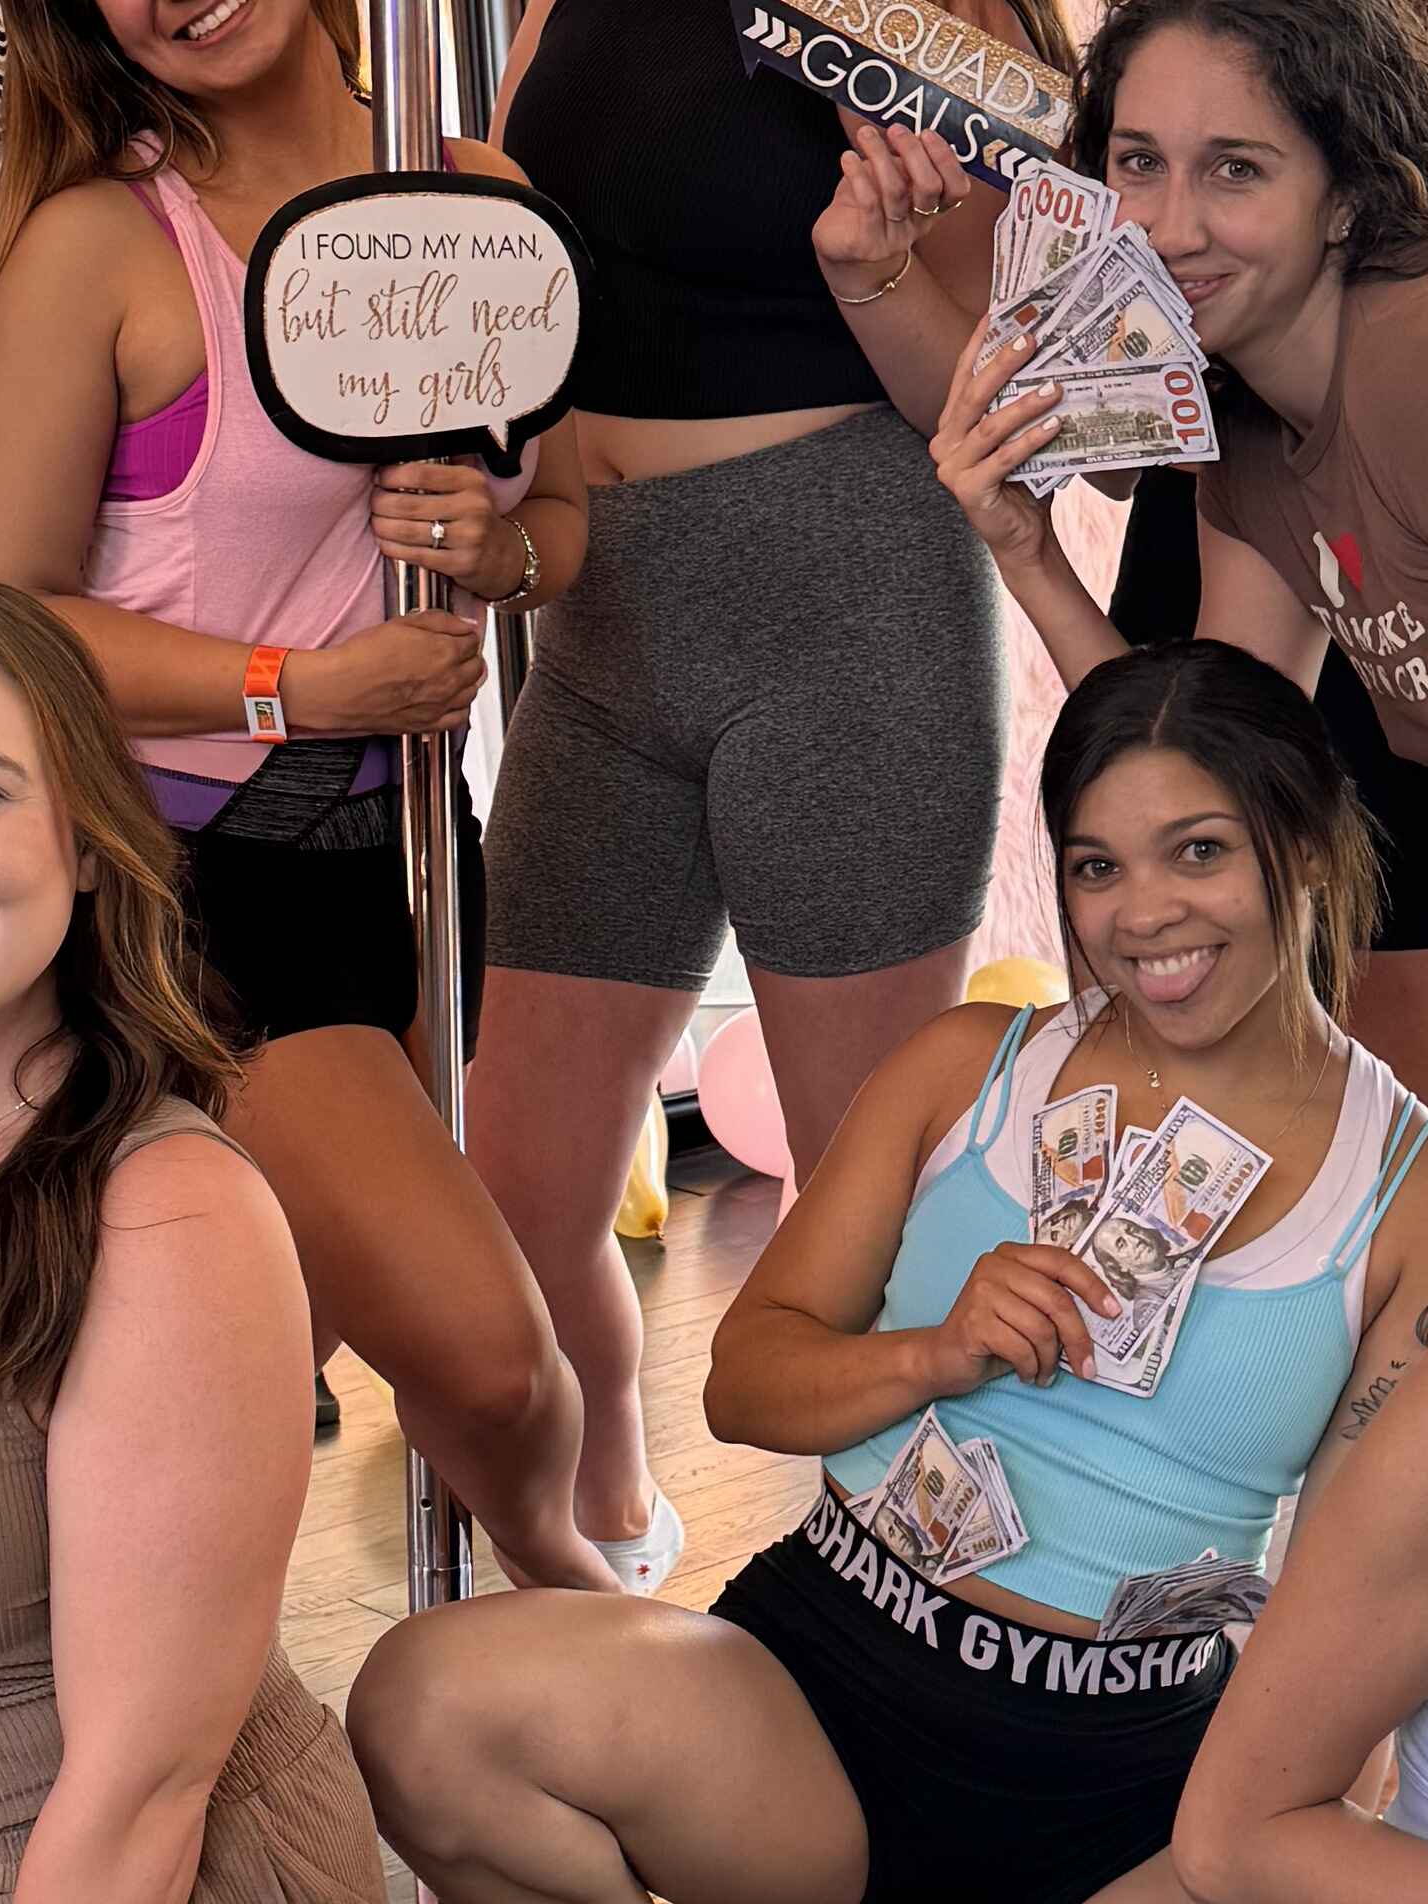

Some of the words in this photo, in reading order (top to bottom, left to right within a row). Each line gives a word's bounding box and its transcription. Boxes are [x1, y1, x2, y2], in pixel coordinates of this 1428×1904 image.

[1034, 177, 1087, 229] 100
[300, 234, 307, 260] I
[317, 233, 412, 260] FOUND
[422, 233, 461, 260] MY
[472, 233, 544, 261] MAN,
[278, 267, 351, 343] but
[361, 270, 458, 340] still
[472, 267, 569, 336] need
[339, 372, 400, 425] my
[418, 337, 511, 428] girls
[1164, 370, 1206, 445] 100
[960, 1614, 1221, 1696] GYMSHAR
